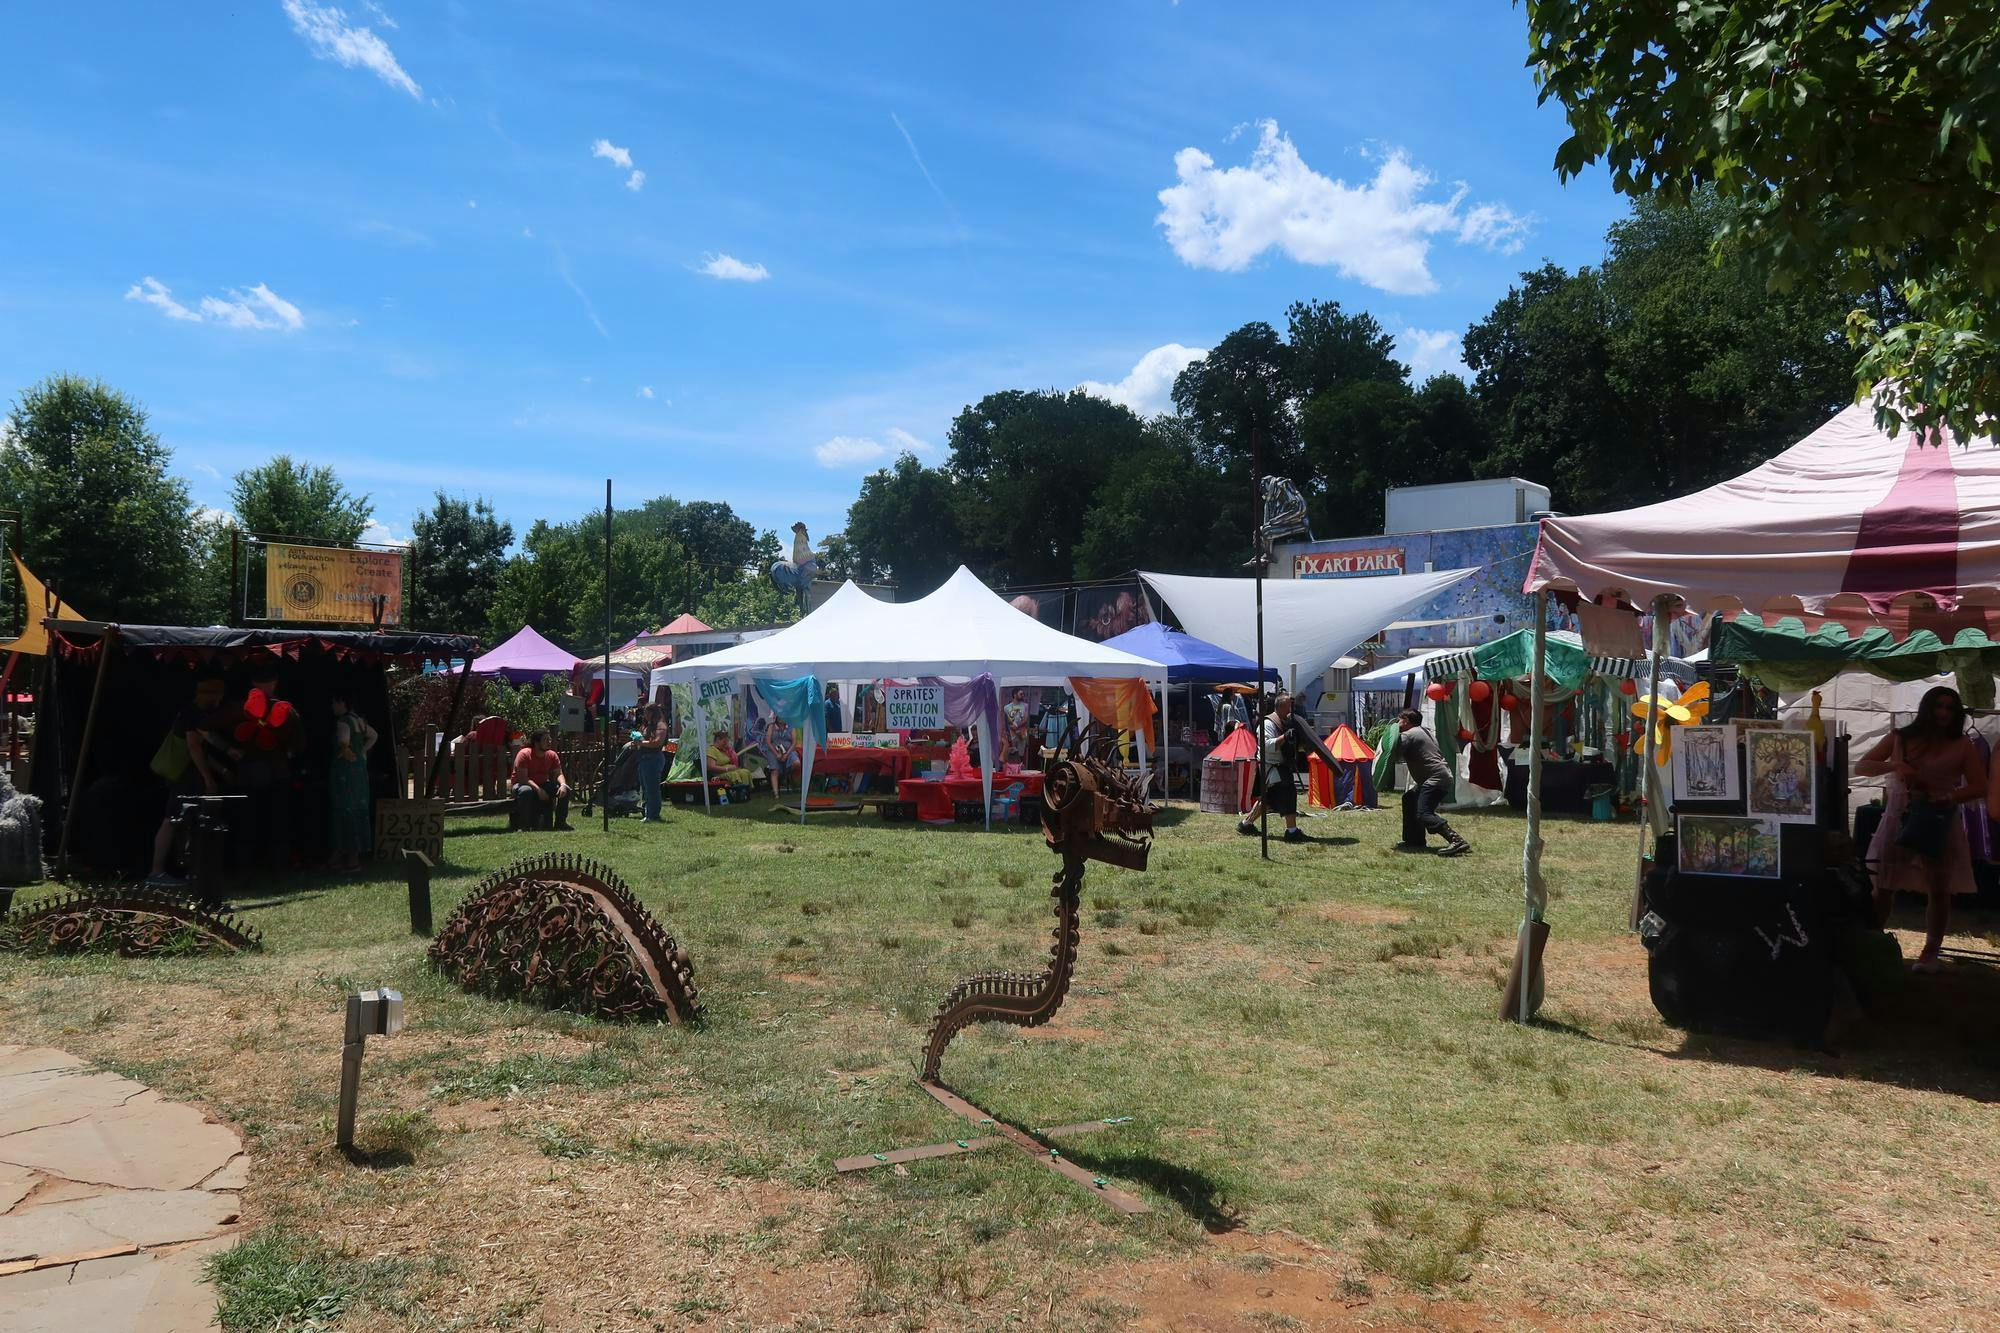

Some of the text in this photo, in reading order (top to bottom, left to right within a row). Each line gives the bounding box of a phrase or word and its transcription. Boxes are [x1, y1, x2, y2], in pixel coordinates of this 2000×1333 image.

[350, 554, 390, 566] Explore
[1301, 559, 1320, 575] IX
[1322, 557, 1354, 573] ART
[1356, 553, 1400, 571] PARK
[356, 566, 392, 577] Create
[700, 677, 732, 698] ENTER
[889, 703, 938, 714] CREATION
[892, 716, 936, 728] STATION
